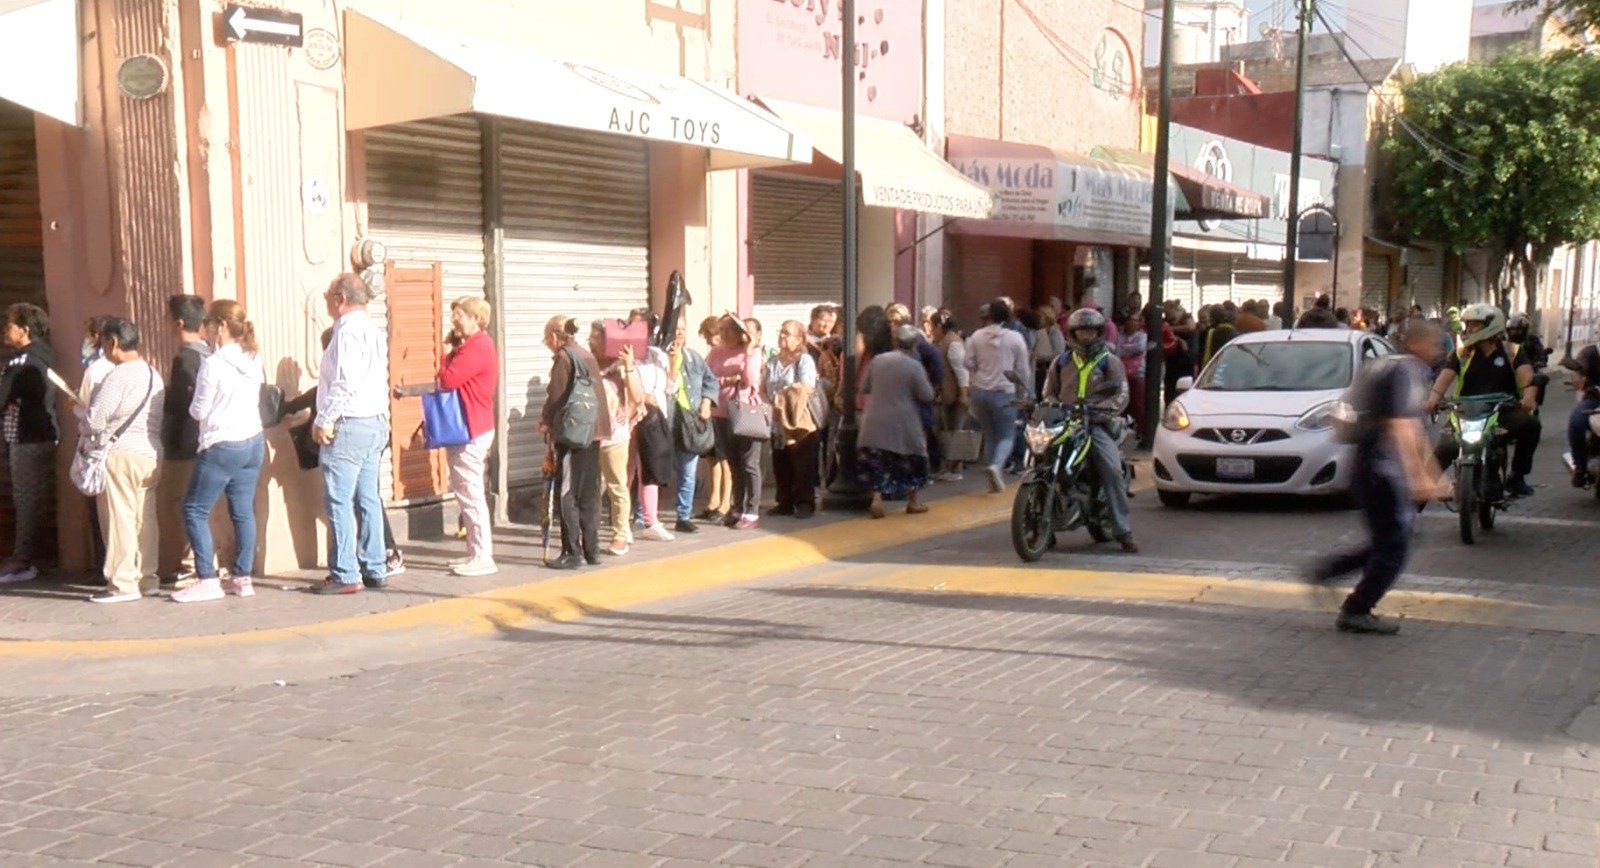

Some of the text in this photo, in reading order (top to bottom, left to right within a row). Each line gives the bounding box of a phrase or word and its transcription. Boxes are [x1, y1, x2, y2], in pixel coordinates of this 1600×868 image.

[608, 105, 721, 145] AJC TOYS
[996, 162, 1054, 189] Moda
[873, 185, 900, 203] VENTA
[900, 188, 912, 205] DE
